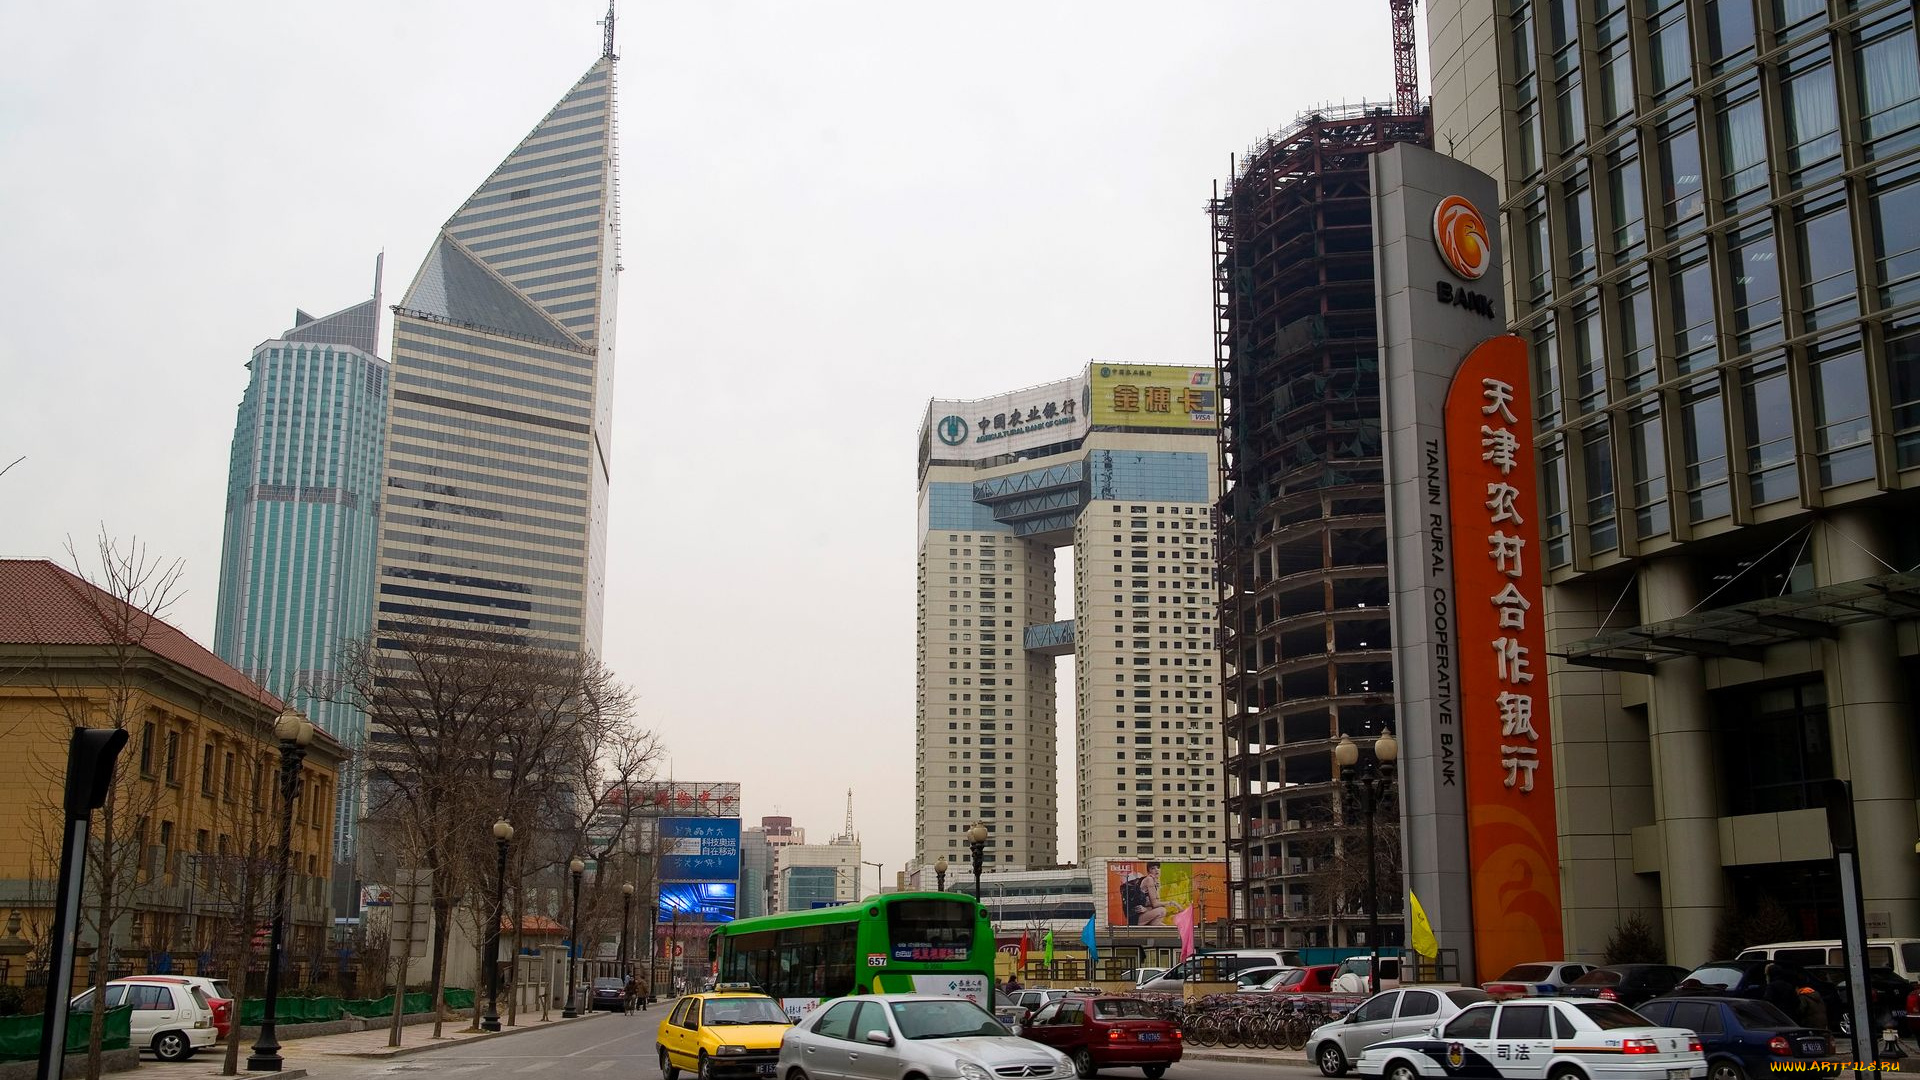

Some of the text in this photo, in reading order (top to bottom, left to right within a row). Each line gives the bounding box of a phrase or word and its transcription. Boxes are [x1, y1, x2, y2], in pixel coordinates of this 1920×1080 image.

[1437, 281, 1495, 319] BANK
[1113, 385, 1203, 413] 金穗卡
[976, 428, 1025, 443] AGRICULTURAL
[1025, 422, 1045, 432] BANK
[1054, 416, 1076, 426] CHINA
[978, 399, 1076, 435] 中国农业银行
[1482, 377, 1539, 793] 天津农村合作银行
[1426, 439, 1456, 786] TIANJIN RURAL COOPERATIVE BANK
[702, 838, 736, 847] 科技奥运
[702, 847, 736, 856] 自在移动
[869, 958, 886, 966] 657
[1497, 1044, 1530, 1061] 司法
